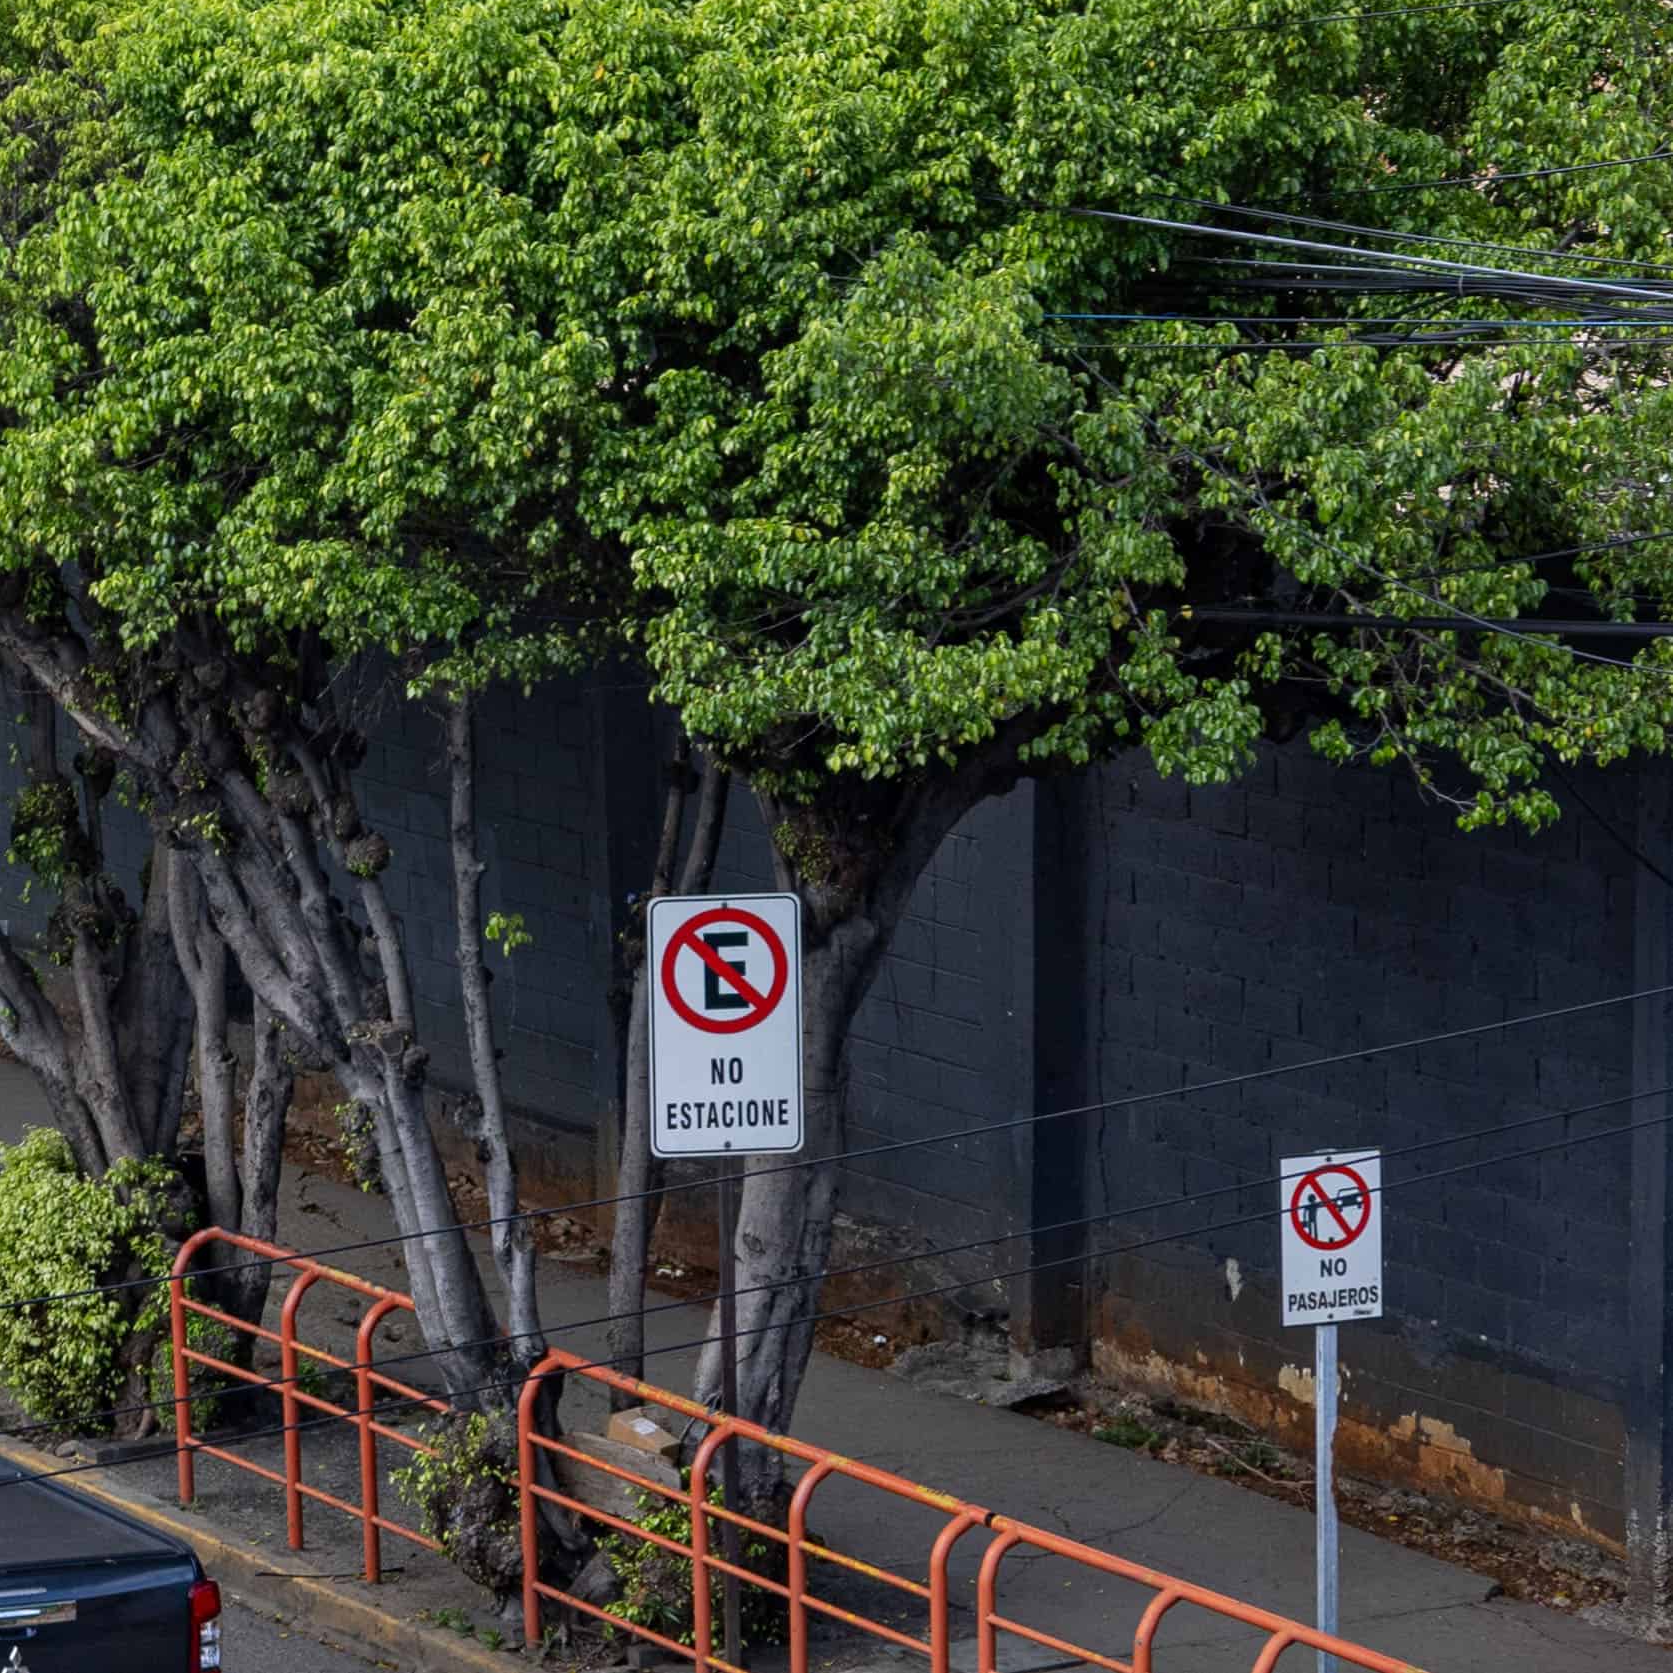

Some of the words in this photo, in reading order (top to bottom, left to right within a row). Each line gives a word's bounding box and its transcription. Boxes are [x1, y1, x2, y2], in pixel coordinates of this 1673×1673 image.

[703, 931, 750, 1010] E
[710, 1057, 743, 1085] NO
[666, 1098, 790, 1131] ESTACIONE
[1320, 1258, 1347, 1278] NO
[1288, 1285, 1379, 1313] PASAJEROS
